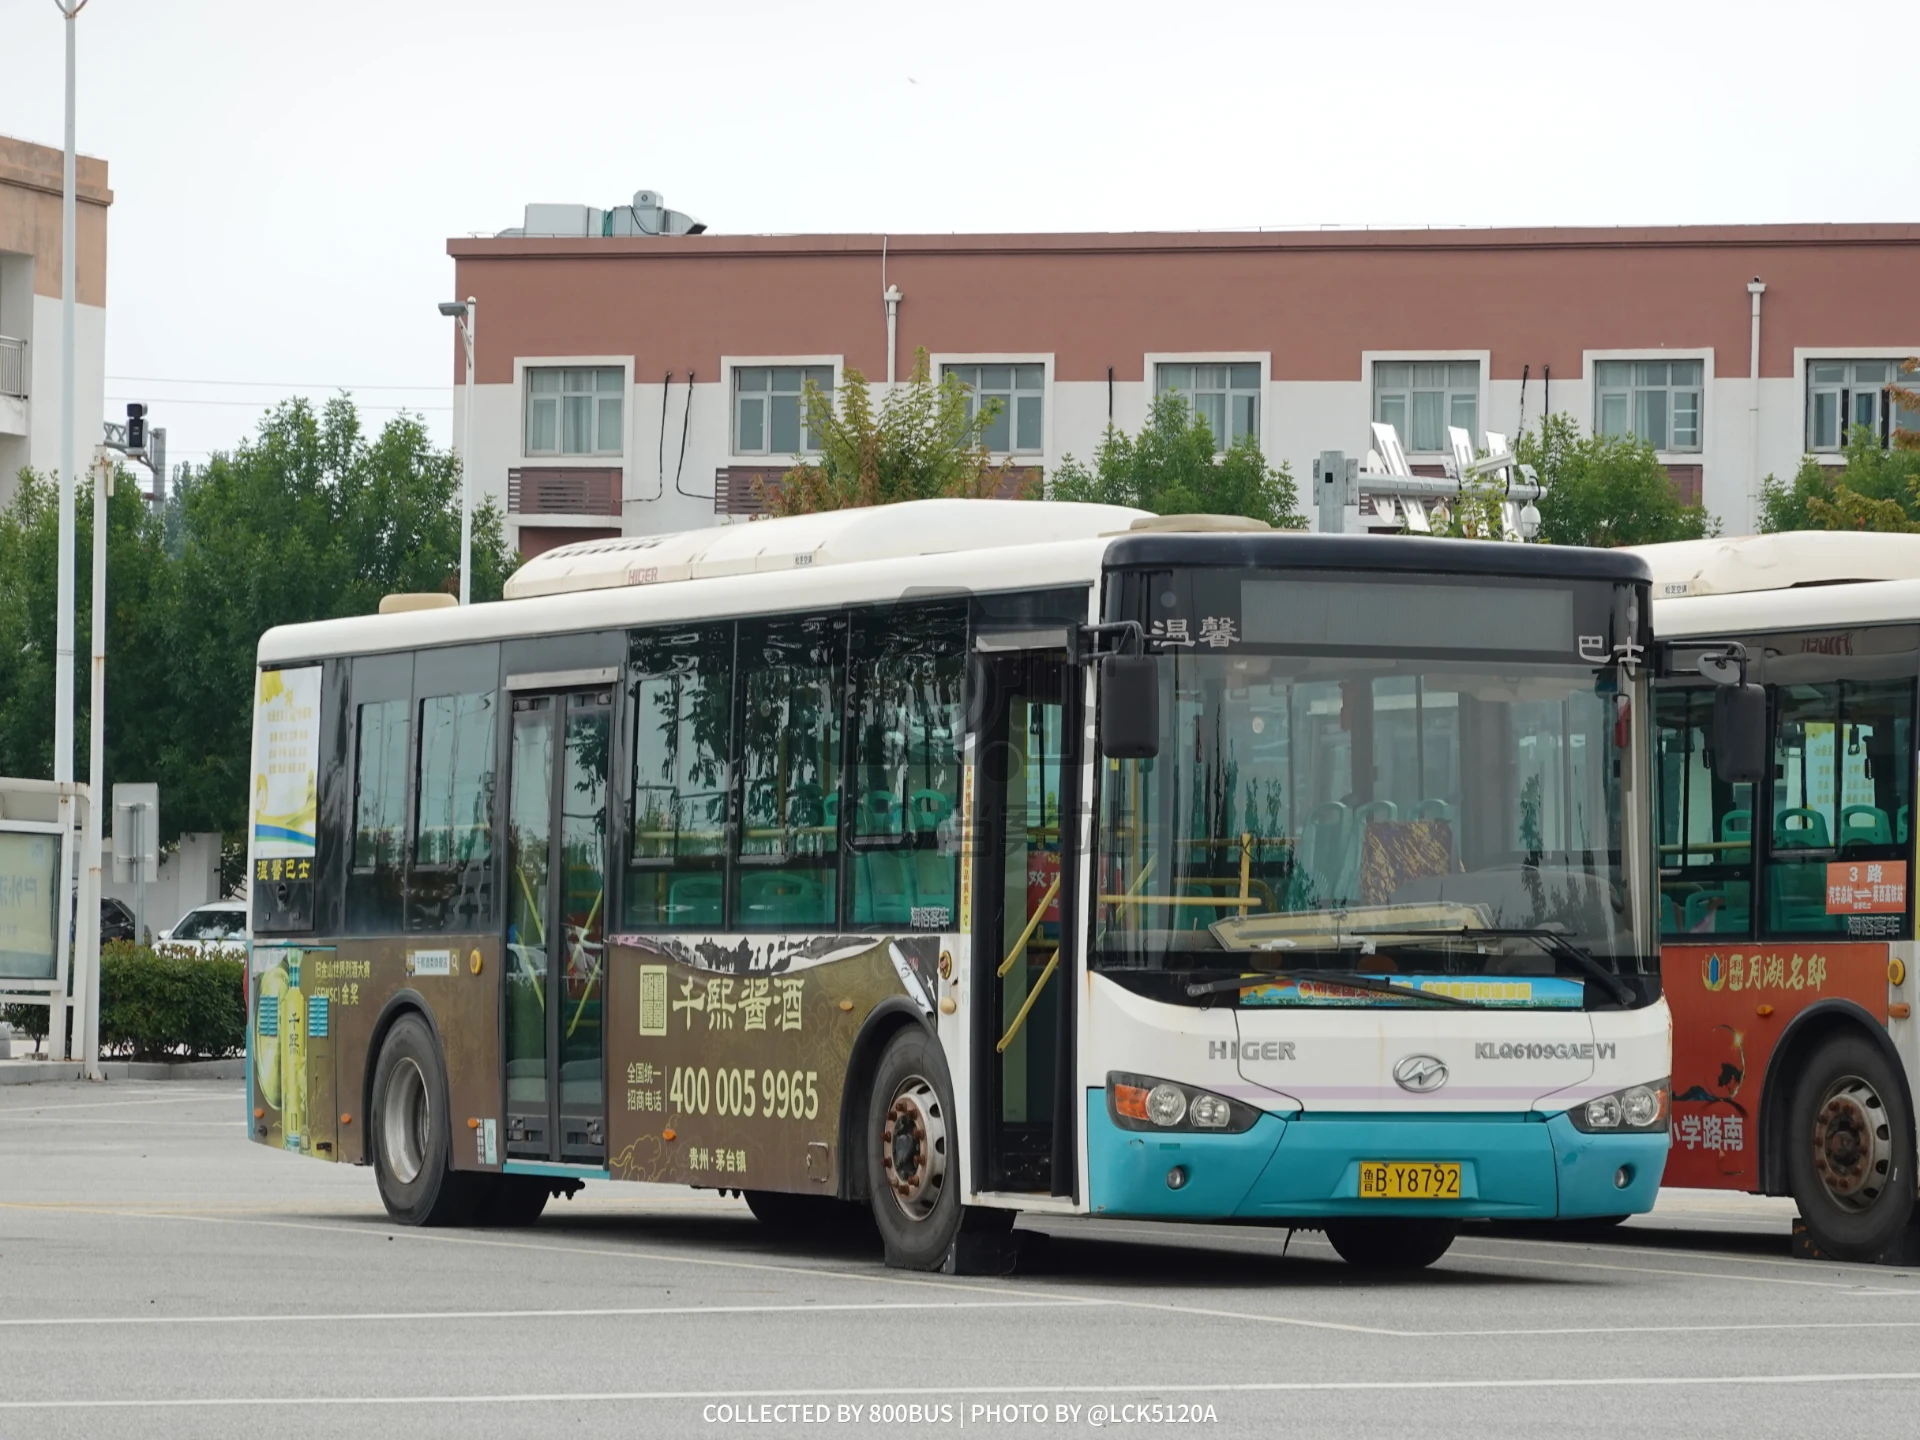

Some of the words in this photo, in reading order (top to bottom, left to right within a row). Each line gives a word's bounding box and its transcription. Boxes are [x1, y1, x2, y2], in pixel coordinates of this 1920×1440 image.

[1665, 584, 1688, 594] 松芝空调
[1151, 616, 1240, 648] 温馨
[1578, 635, 1645, 664] 巴士
[257, 858, 310, 881] 温馨巴士
[1849, 866, 1858, 882] 3
[1867, 864, 1883, 883] 路
[910, 906, 950, 928] 海格客车
[1847, 915, 1900, 935] 海格客车
[341, 982, 359, 1005] 金奖
[672, 976, 805, 1032] 千熙酱酒
[1208, 1041, 1296, 1060] HIGER
[627, 1061, 662, 1085] 全国统一
[627, 1088, 662, 1112] 招商电话
[669, 1066, 710, 1116] 400
[716, 1067, 756, 1117] 005
[762, 1069, 819, 1120] 9965
